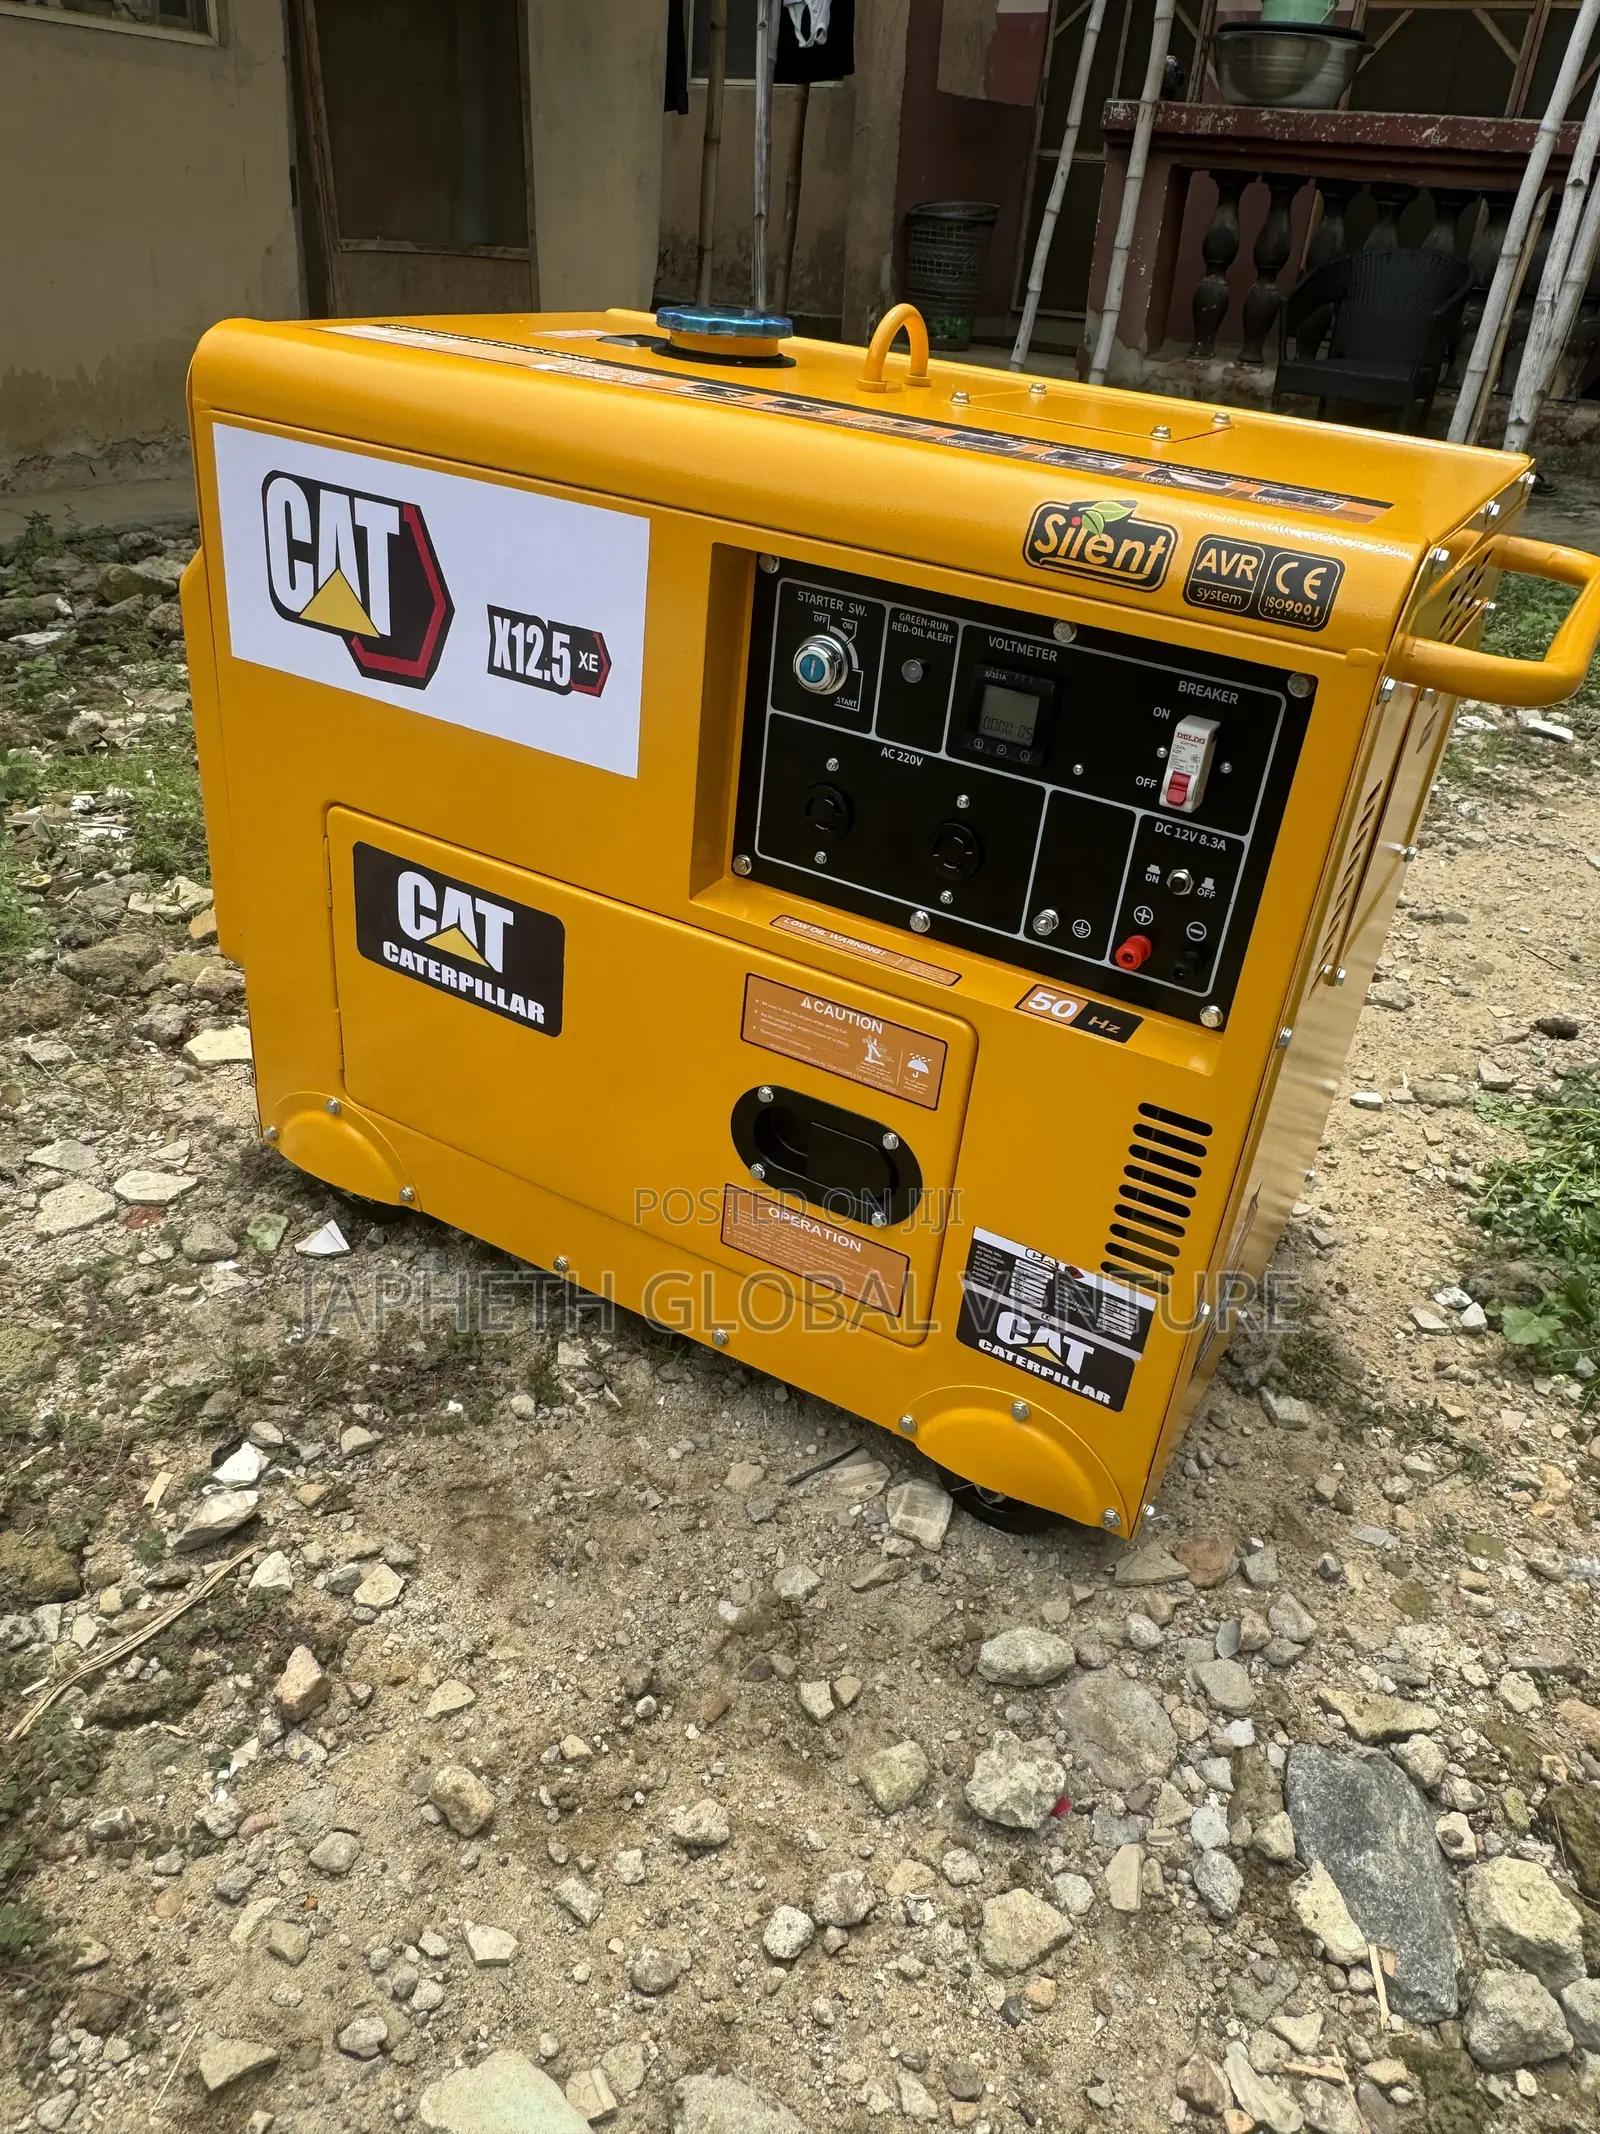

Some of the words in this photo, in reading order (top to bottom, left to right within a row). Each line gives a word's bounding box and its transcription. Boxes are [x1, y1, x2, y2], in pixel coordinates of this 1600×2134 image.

[266, 477, 400, 636] CAT
[1034, 513, 1167, 576] Silent
[1196, 547, 1258, 582] AVR
[1275, 561, 1327, 600] CE
[797, 590, 844, 611] STARTER
[848, 602, 868, 615] SW.
[1196, 587, 1242, 606] system
[1265, 596, 1321, 618] ISO9001
[813, 614, 827, 624] OFF
[842, 621, 853, 631] ON
[899, 612, 949, 632] GREEN-RUN
[892, 621, 925, 638] RED-OIL
[926, 629, 954, 644] ALERT
[493, 615, 572, 687] X12.5
[578, 650, 599, 673] XE
[988, 635, 1058, 662] VOLTMETER
[836, 696, 858, 708] START
[1177, 679, 1239, 705] BREAKER
[1153, 706, 1171, 720] ON
[881, 747, 896, 760] AC
[897, 751, 924, 767] 220V
[1135, 775, 1157, 789] OFF
[1154, 821, 1173, 836] DC
[1174, 827, 1198, 842] 12V
[1199, 834, 1227, 852] 8.3A
[1145, 873, 1159, 884] ON
[1196, 887, 1216, 899] OFF
[397, 871, 514, 974] CAT
[783, 917, 809, 931] LOW
[809, 925, 827, 937] OIL
[829, 932, 887, 956] WARNING!
[383, 940, 545, 1024] CATERPILLAR
[813, 1000, 884, 1035] CAUTION
[1028, 991, 1078, 1018] 50
[1088, 1015, 1121, 1034] Hz
[768, 1206, 862, 1253] OPERATION
[1027, 1248, 1072, 1271] CAT
[996, 1311, 1095, 1375] CAT
[978, 1338, 1111, 1405] CATERPILLAR
